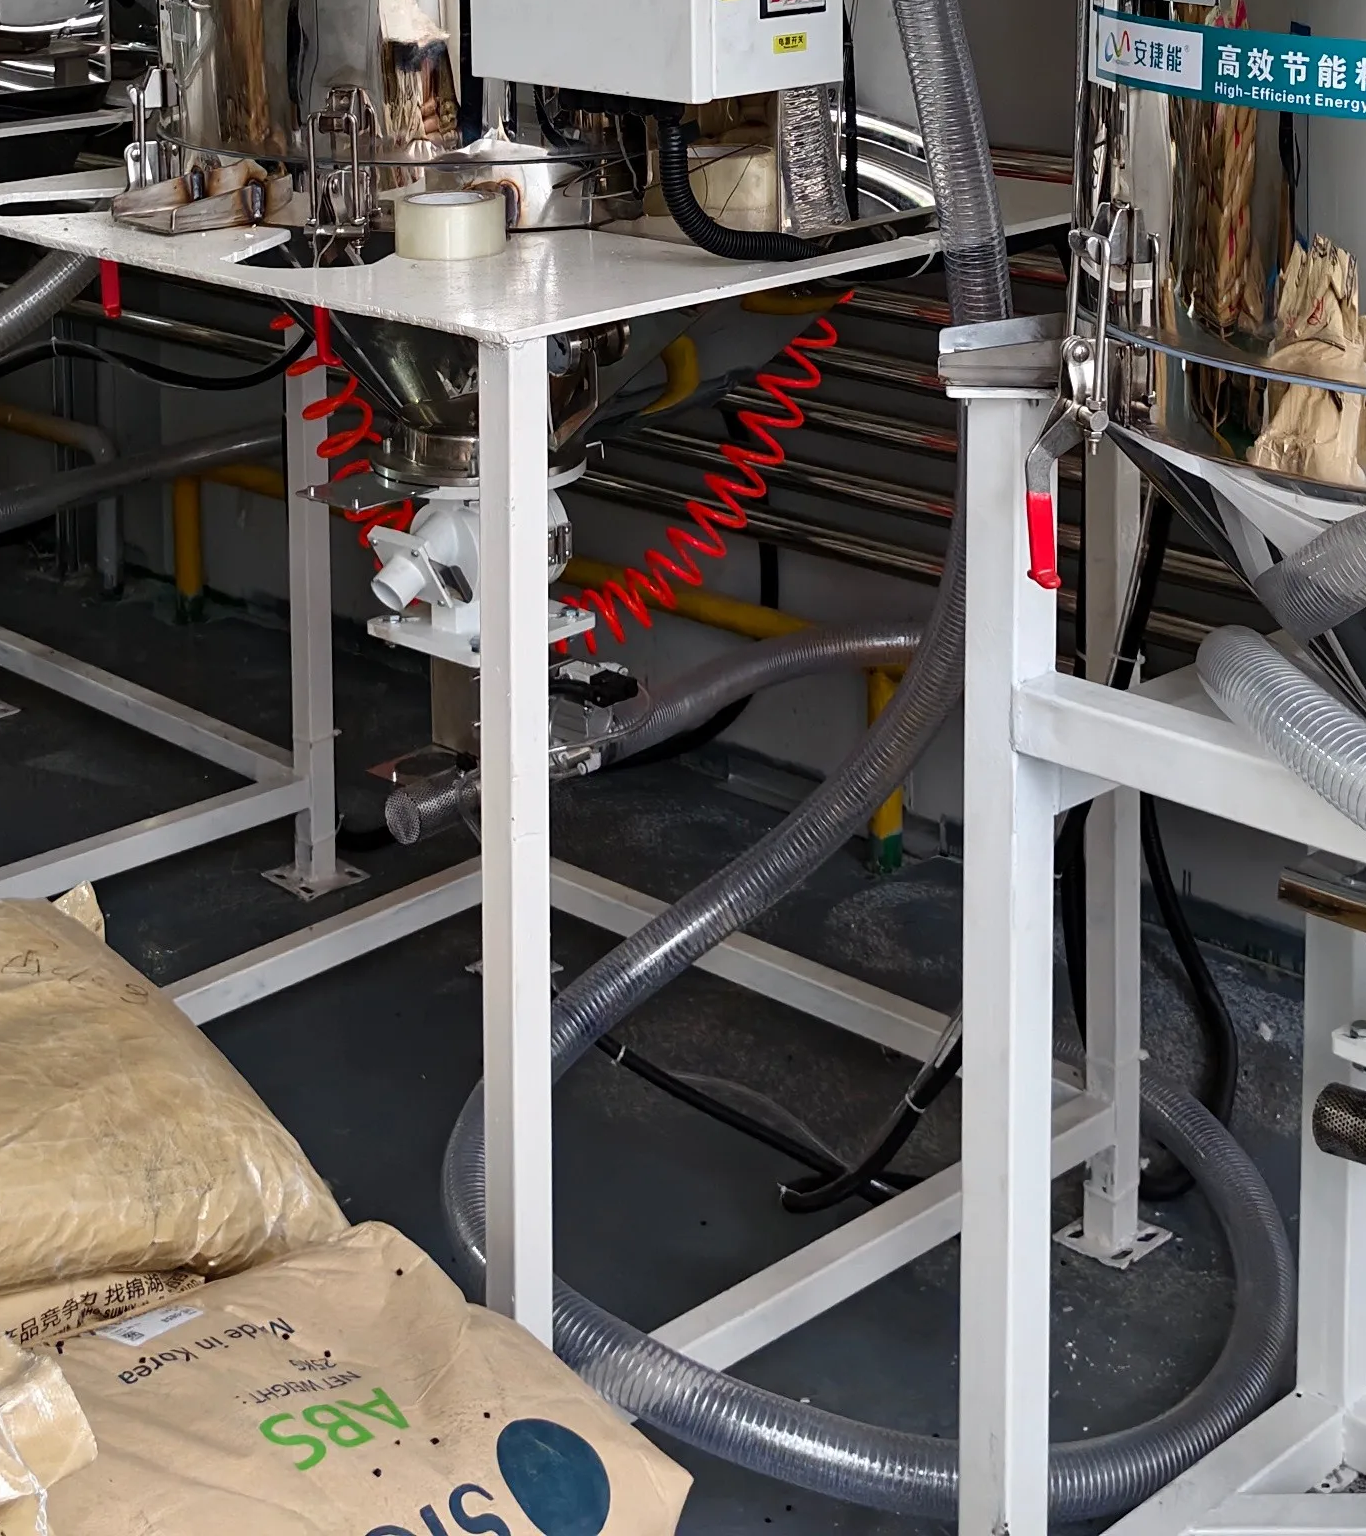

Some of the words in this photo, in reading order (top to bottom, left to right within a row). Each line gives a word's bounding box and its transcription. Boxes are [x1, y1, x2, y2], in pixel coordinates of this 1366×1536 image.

[1133, 39, 1183, 74] 安捷能
[1214, 81, 1312, 106] High-Efficient
[194, 1337, 229, 1360] in
[117, 1348, 193, 1388] Korea
[287, 1355, 339, 1374] 25KG
[249, 1378, 319, 1406] WEIGHT
[314, 1370, 362, 1394] NET
[258, 1386, 413, 1471] ABS
